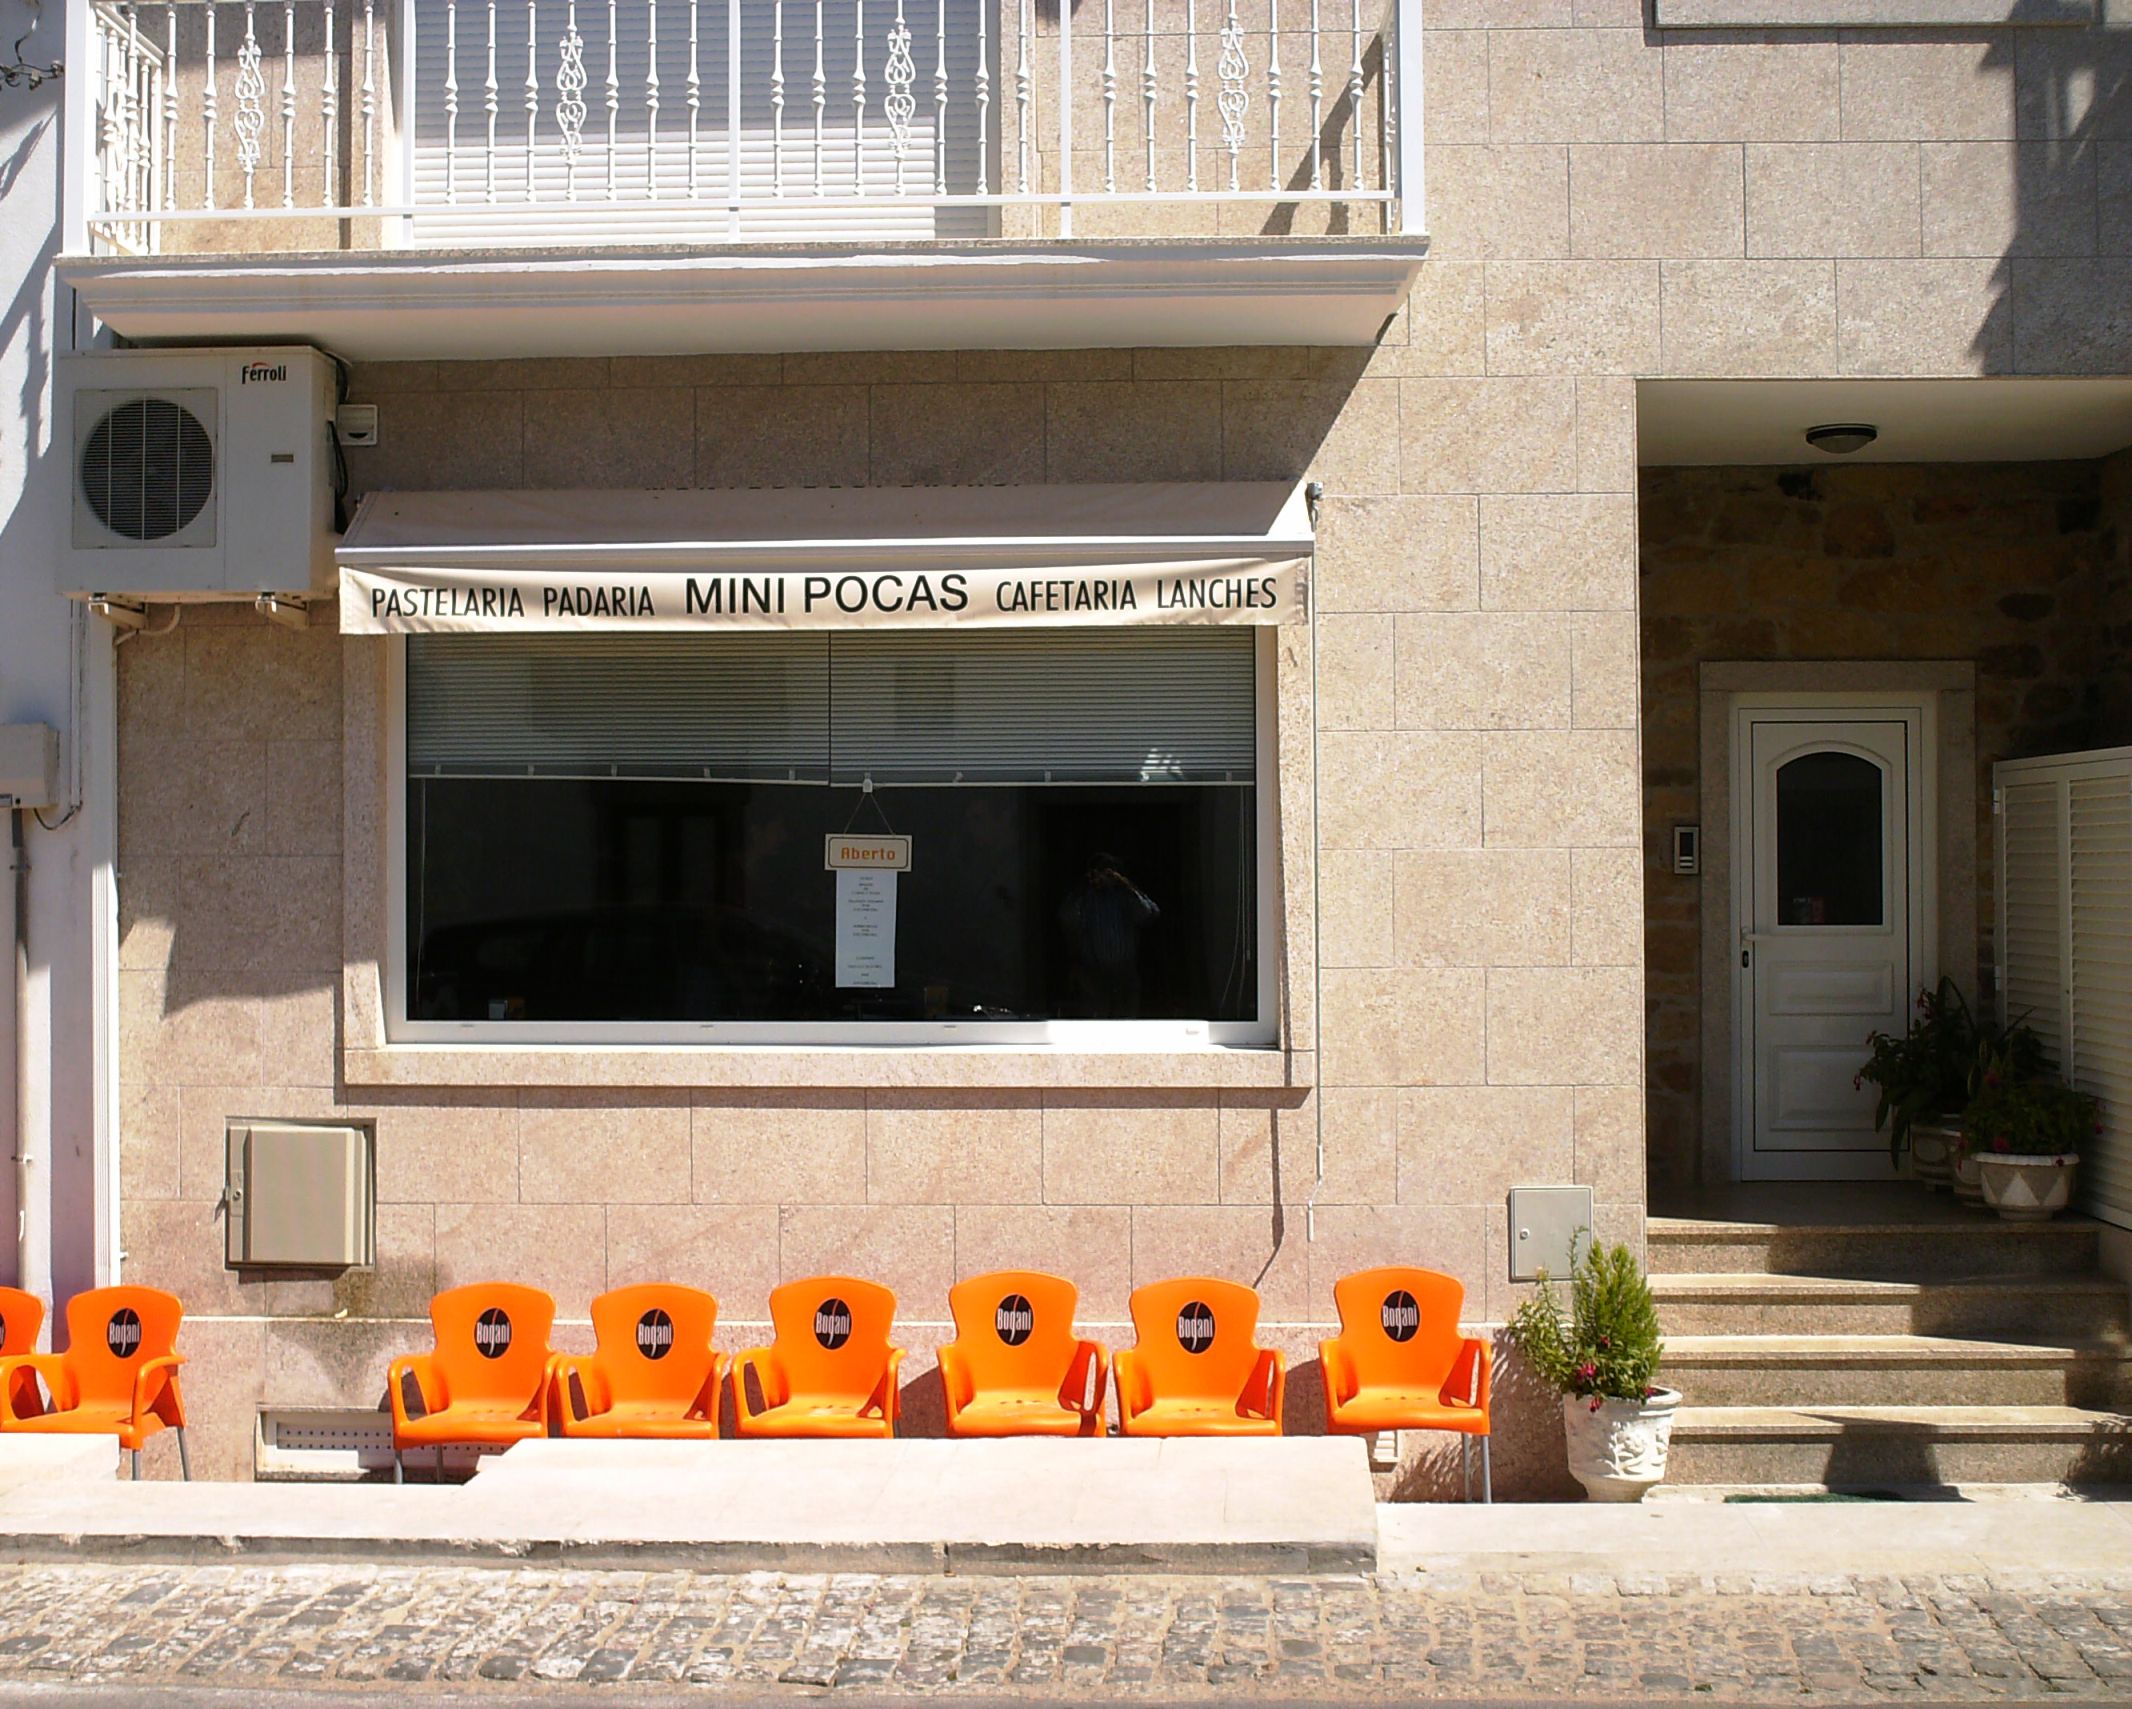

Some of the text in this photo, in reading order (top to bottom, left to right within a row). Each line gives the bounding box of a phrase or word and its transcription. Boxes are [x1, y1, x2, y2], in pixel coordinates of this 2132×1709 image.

[241, 365, 287, 384] Ferroli
[371, 574, 1278, 618] PASTELARIA PADARIA MINI POCAS CAFETARIA LANCHES
[840, 847, 897, 861] Aberto
[109, 1321, 140, 1355] Bogani
[476, 1321, 510, 1356] Bogani
[816, 1311, 851, 1347] Bogani
[997, 1308, 1032, 1343] Bogani
[1178, 1315, 1213, 1351] Bogani
[1382, 1304, 1418, 1340] Bogani
[638, 1323, 672, 1357] Bogani
